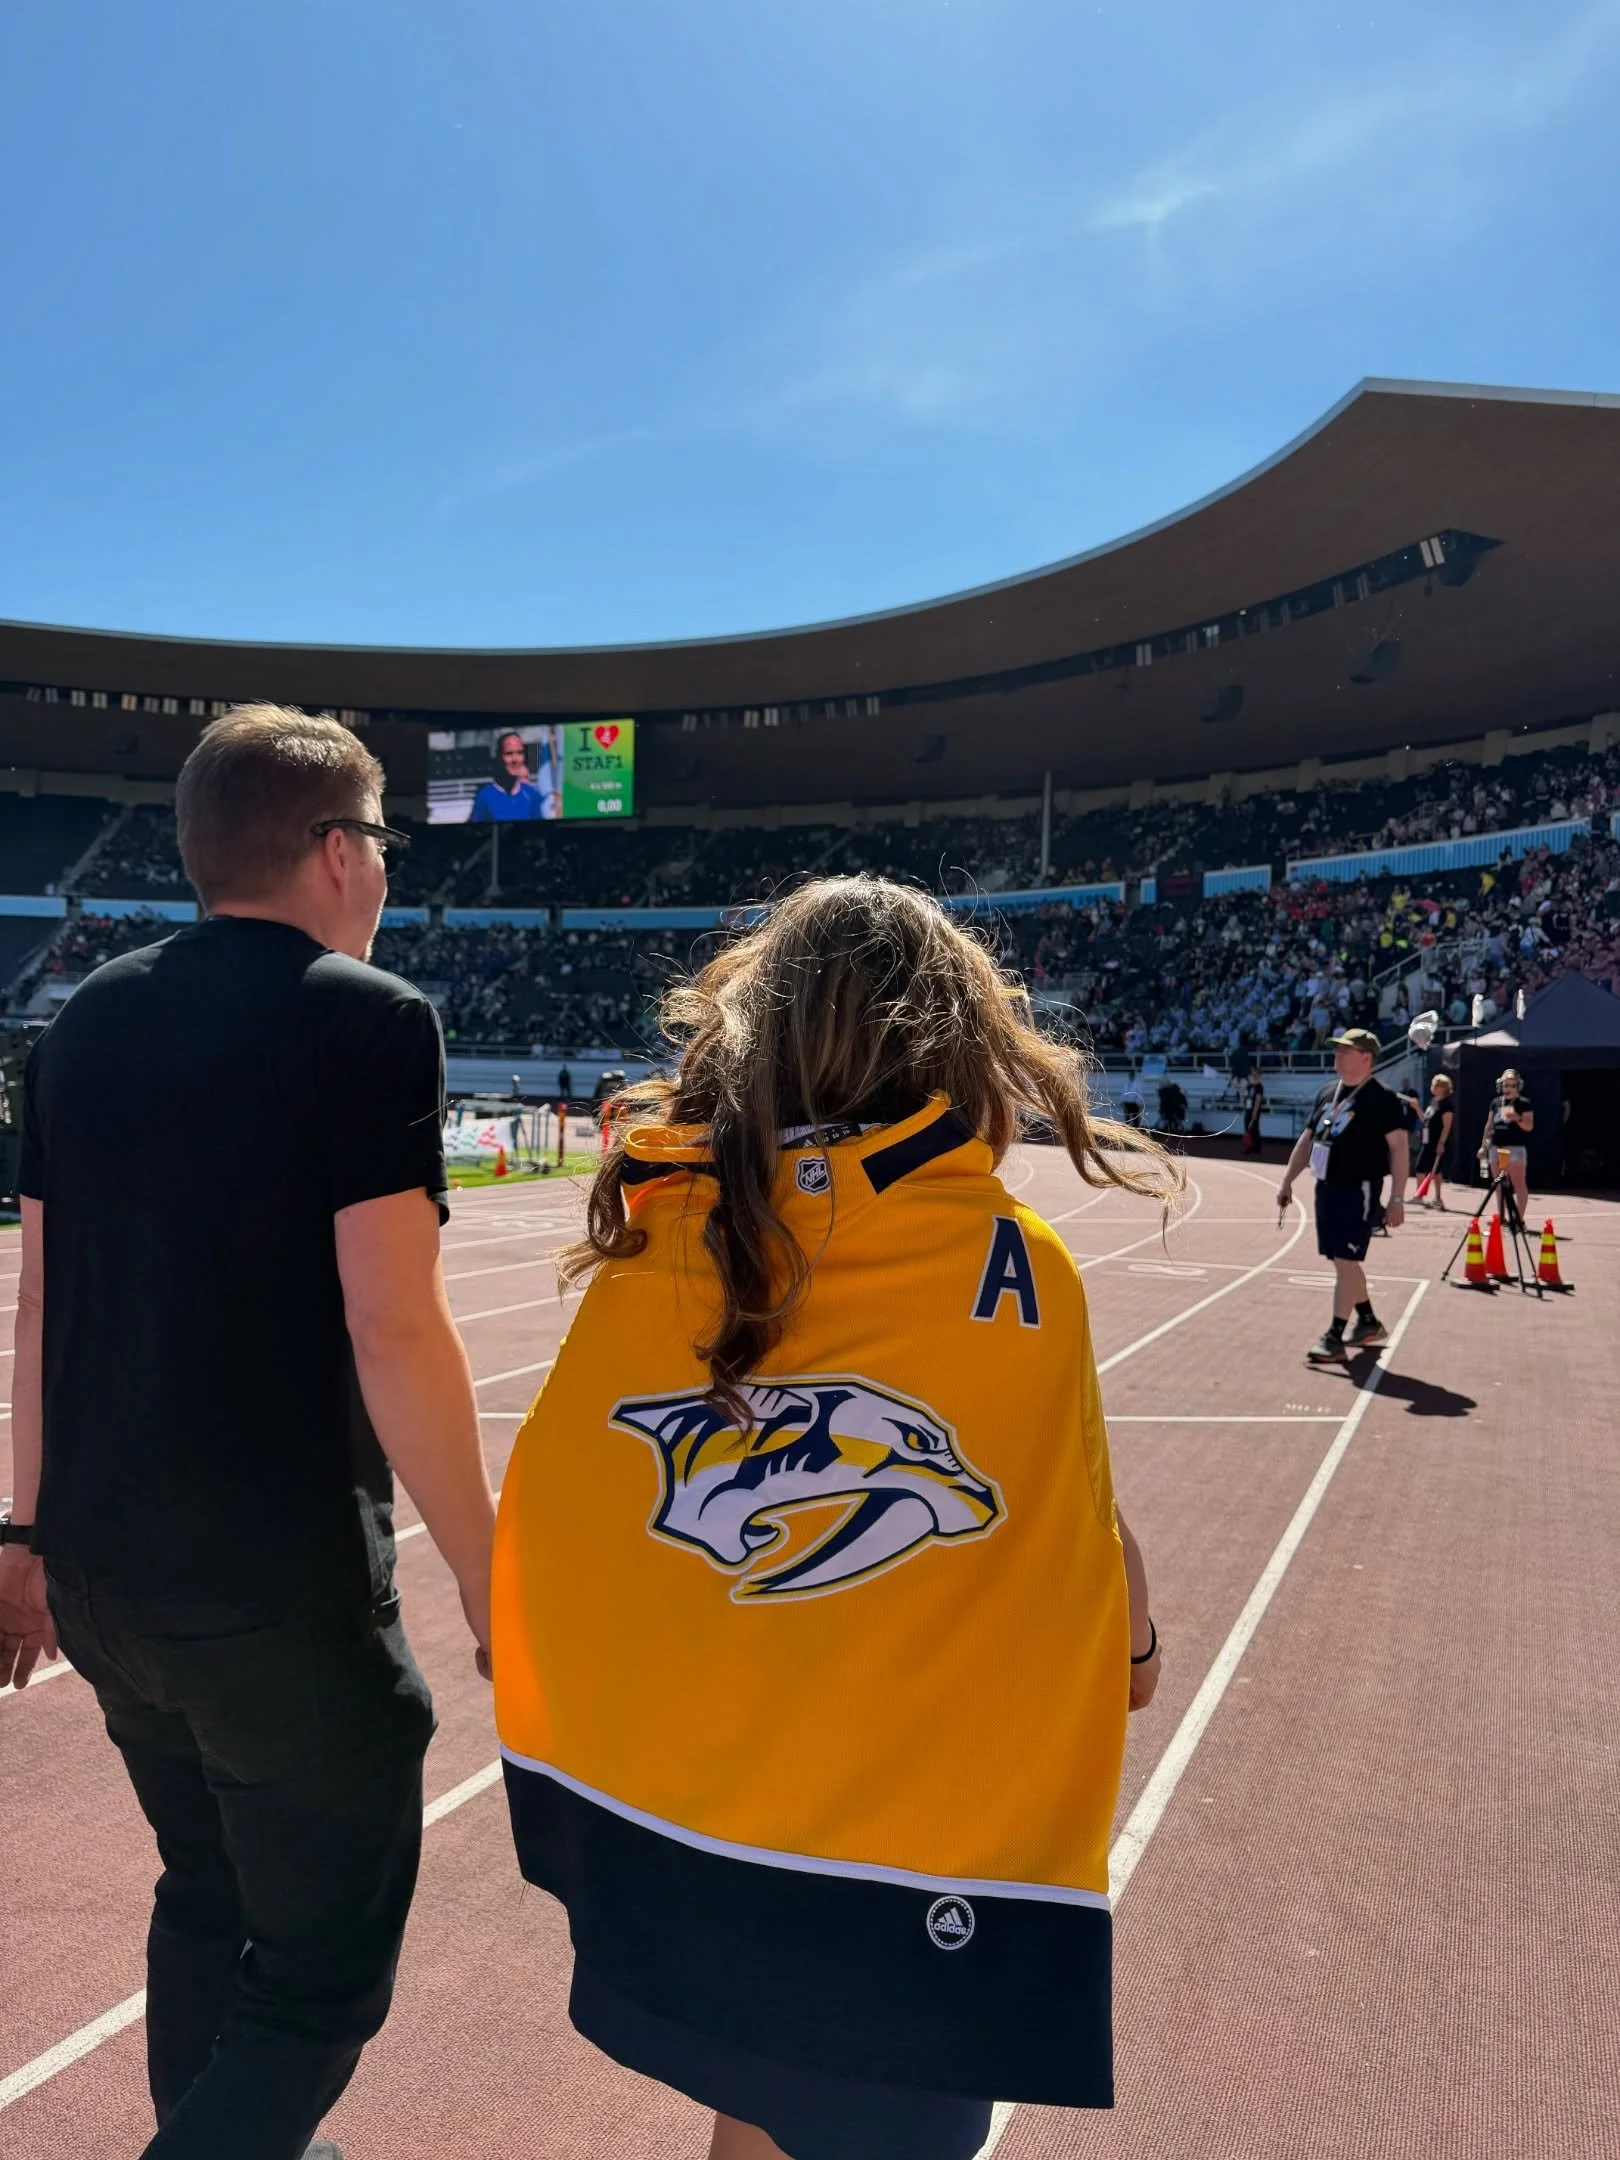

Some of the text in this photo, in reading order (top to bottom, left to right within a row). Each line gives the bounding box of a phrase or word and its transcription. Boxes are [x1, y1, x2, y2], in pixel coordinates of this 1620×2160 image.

[579, 727, 592, 752] I
[804, 1165, 826, 1187] NHL
[969, 1214, 1041, 1329] A
[933, 1922, 967, 1935] adidas
